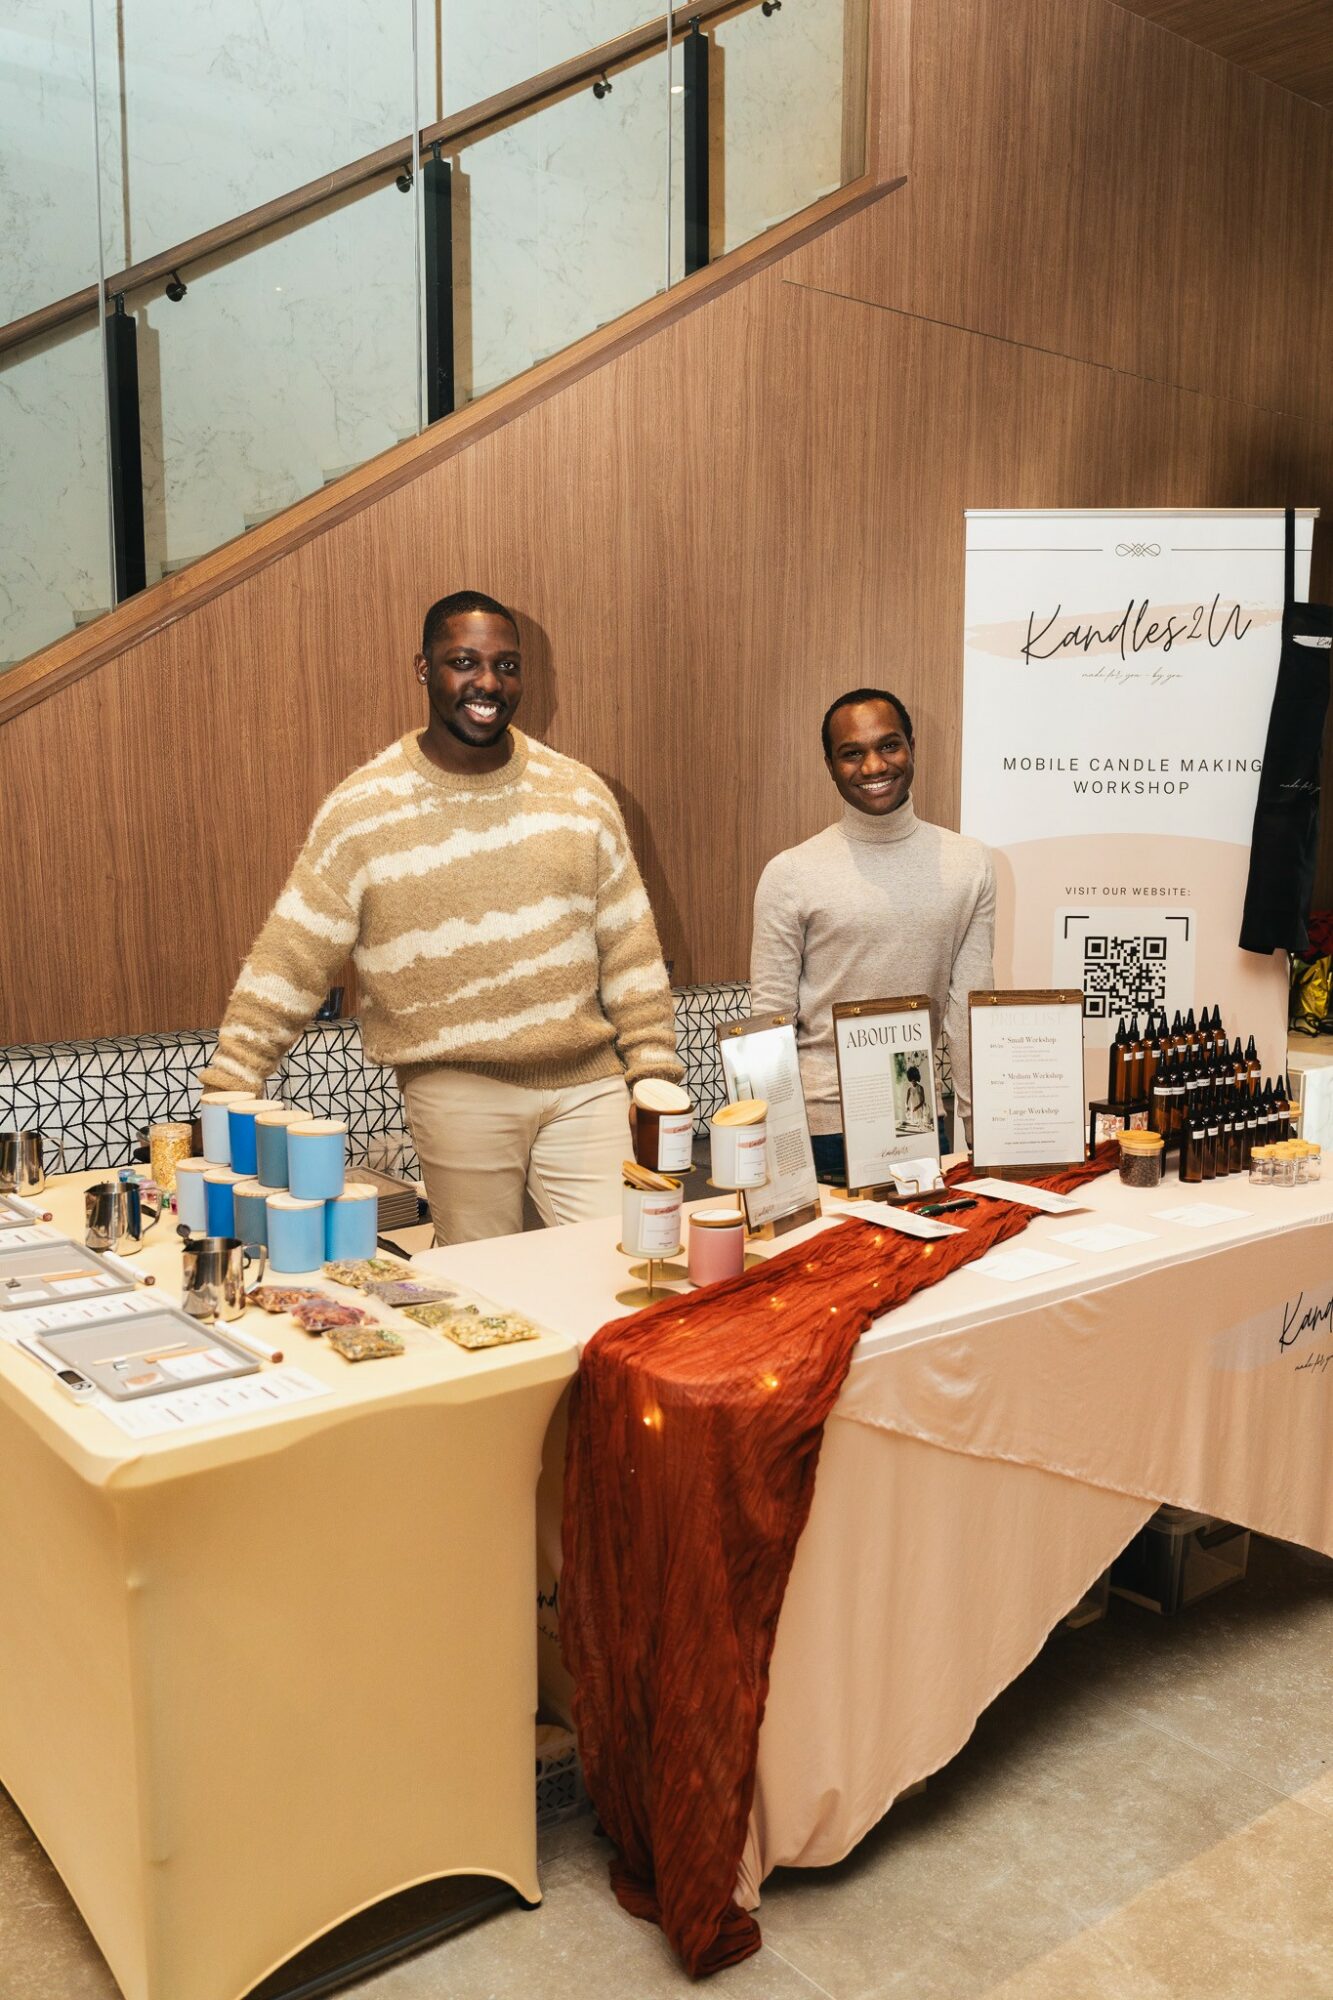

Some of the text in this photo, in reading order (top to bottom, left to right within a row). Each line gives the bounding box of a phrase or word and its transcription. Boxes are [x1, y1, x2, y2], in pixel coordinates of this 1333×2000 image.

[1003, 757, 1262, 774] MOBILE CANDLE MAKING
[1073, 780, 1190, 795] WORKSHOP
[1065, 886, 1192, 897] VISIT OUR WEBSITE:
[846, 1023, 922, 1049] ABOUT US
[1025, 1036, 1056, 1045] Workshop
[1032, 1071, 1064, 1081] Workshop
[1027, 1107, 1060, 1116] Workshop
